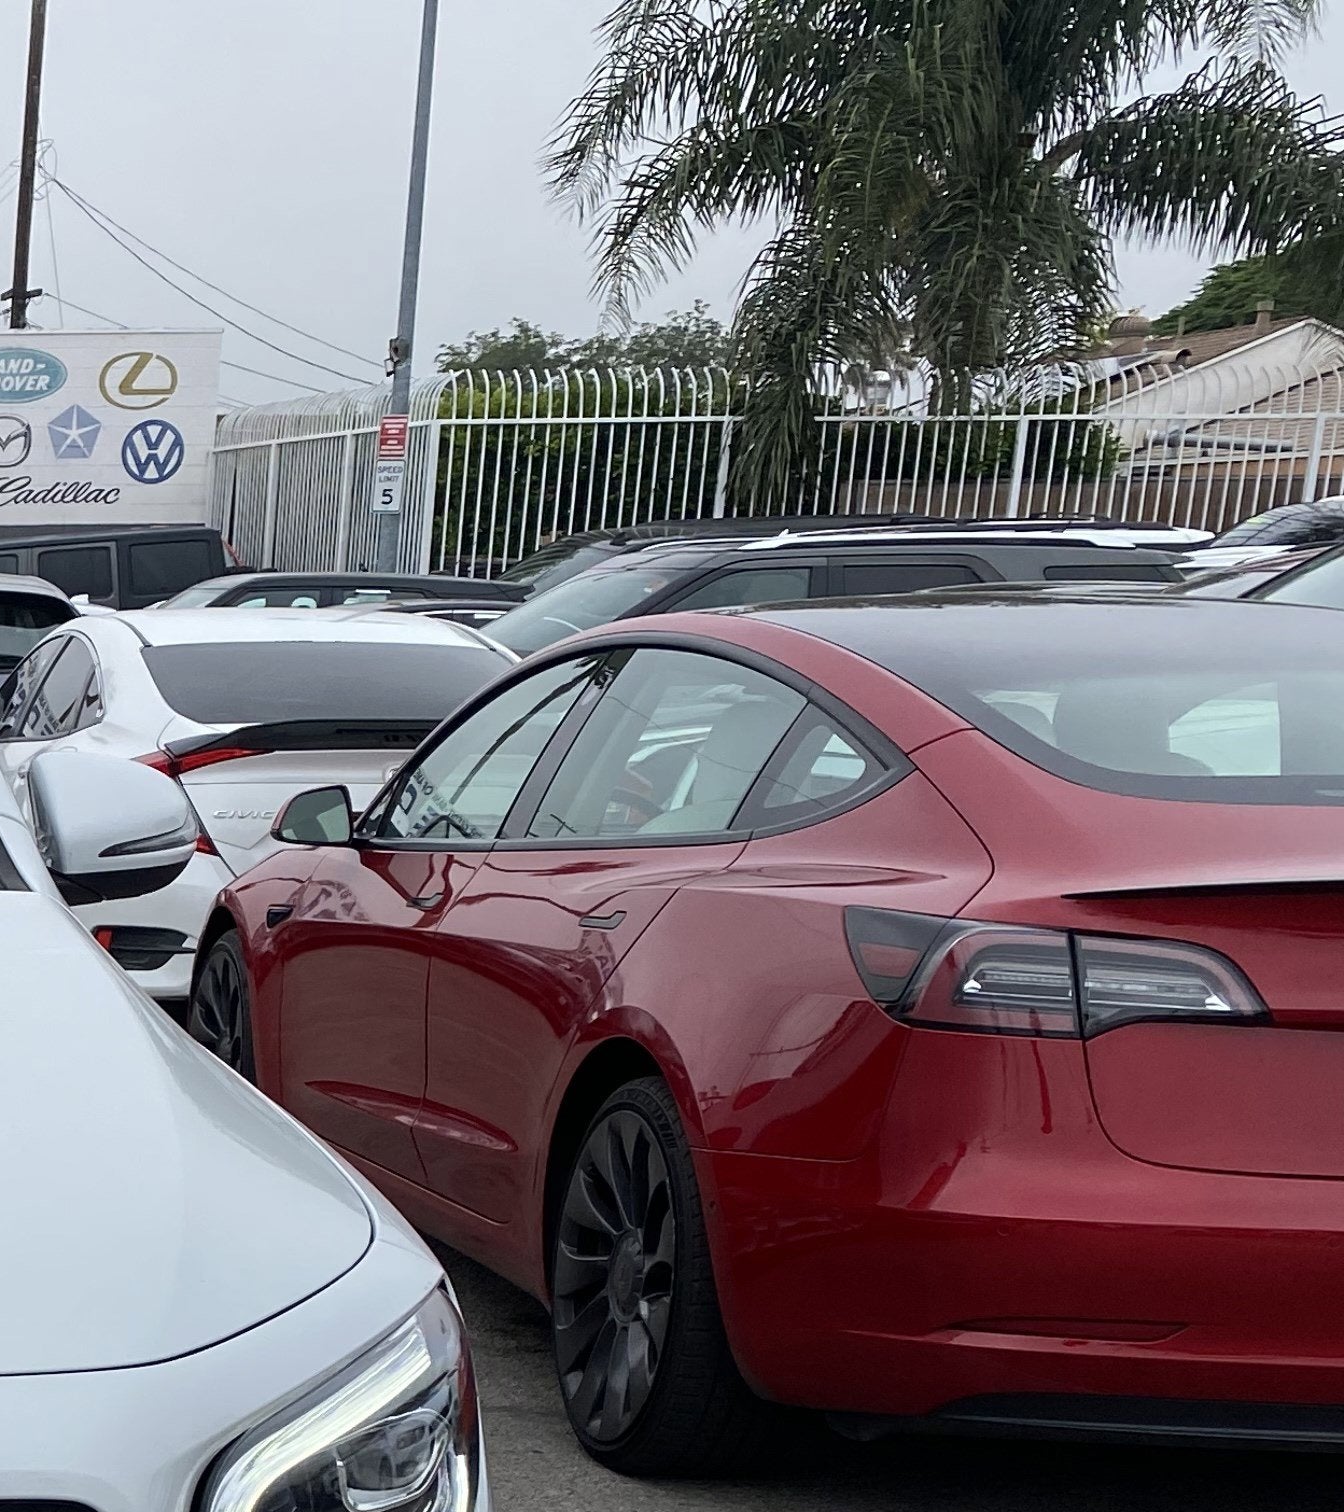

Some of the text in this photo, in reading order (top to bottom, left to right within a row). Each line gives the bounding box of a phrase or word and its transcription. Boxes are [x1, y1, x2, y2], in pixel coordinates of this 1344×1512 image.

[377, 465, 404, 474] SPEED
[378, 475, 400, 483] LIMIT
[381, 488, 394, 505] 5
[212, 809, 276, 819] CIVIC
